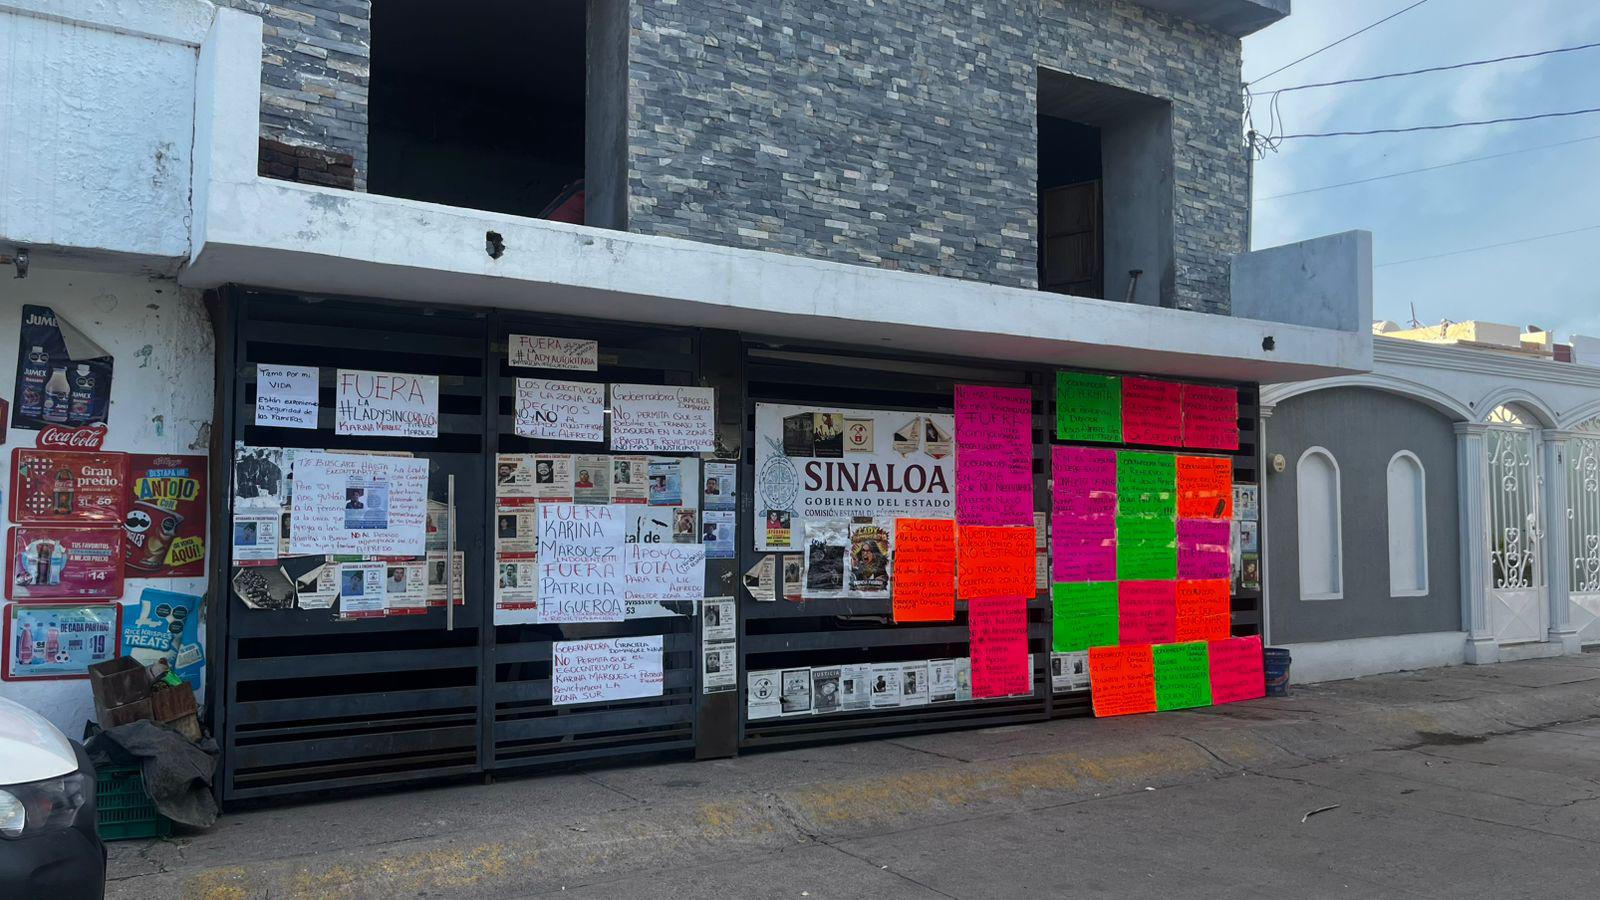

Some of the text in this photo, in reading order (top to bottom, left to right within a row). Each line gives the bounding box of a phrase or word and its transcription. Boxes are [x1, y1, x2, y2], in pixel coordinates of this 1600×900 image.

[520, 337, 562, 350] FUERA
[24, 368, 47, 377] JUMEX
[269, 382, 292, 390] VIDA
[341, 373, 425, 405] FUERA
[517, 380, 541, 390] LOS
[519, 390, 535, 399] DE
[540, 391, 555, 400] LA
[521, 400, 591, 415] DECIMOS
[536, 410, 559, 424] NO
[637, 409, 670, 419] PERMITA
[558, 429, 601, 441] ALFREDO
[658, 428, 671, 436] EN
[81, 466, 113, 477] Gran
[804, 460, 951, 494] SINALOA
[77, 476, 118, 488] precio
[140, 479, 195, 498] ANTOJO
[804, 497, 951, 508] GOBIERNO DEL ESTADO
[543, 504, 612, 521] FUERA
[804, 507, 839, 518] COMISIÓN
[545, 520, 605, 542] KARINA
[859, 526, 881, 537] LADY
[644, 531, 661, 544] de
[541, 540, 615, 560] MARQUEZ
[633, 543, 681, 560] APOYO
[544, 562, 616, 578] FUERA
[629, 560, 688, 575] TOTAL
[541, 576, 616, 596] PATRICIA
[540, 596, 621, 615] FIGUEROA
[626, 607, 636, 615] 53
[61, 624, 69, 632] DE
[69, 624, 84, 632] CADA
[124, 628, 140, 636] RICE
[125, 636, 169, 649] TREATS
[555, 653, 570, 667] NO
[624, 663, 635, 671] DE
[556, 673, 587, 684] KARINA
[813, 669, 842, 679] JUSTICIA
[555, 690, 606, 703] ZONA SUR
